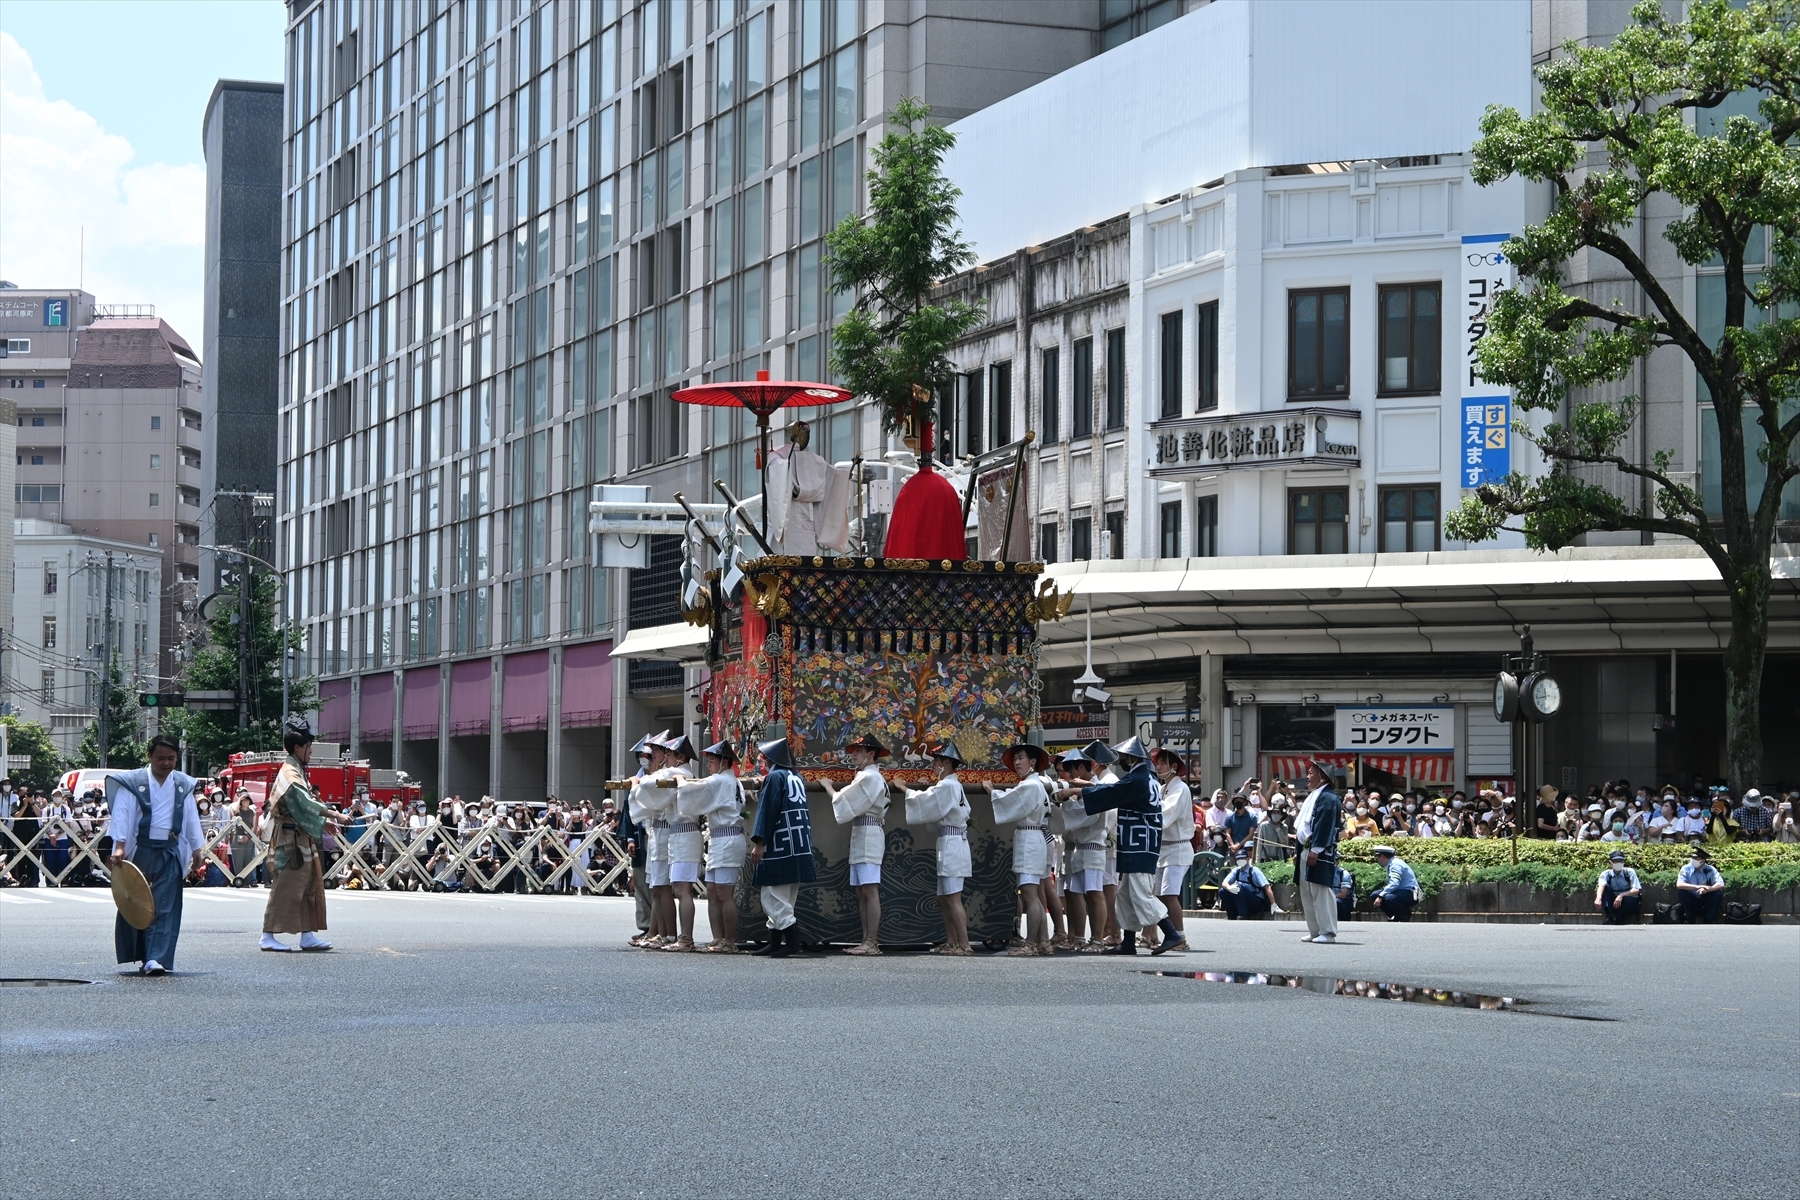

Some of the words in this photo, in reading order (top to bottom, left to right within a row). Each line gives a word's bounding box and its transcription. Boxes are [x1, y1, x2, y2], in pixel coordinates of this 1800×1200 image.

[1314, 415, 1357, 456] ikezen
[1487, 407, 1504, 447] すぐ
[1156, 423, 1306, 464] 池善化粧品店
[1465, 405, 1484, 486] 買えます
[1037, 711, 1088, 725] セスチケット
[1380, 712, 1439, 723] メガネスーパー
[1076, 728, 1093, 739] ACCESS
[1094, 727, 1110, 738] TICKET
[1351, 727, 1439, 744] コンタクト
